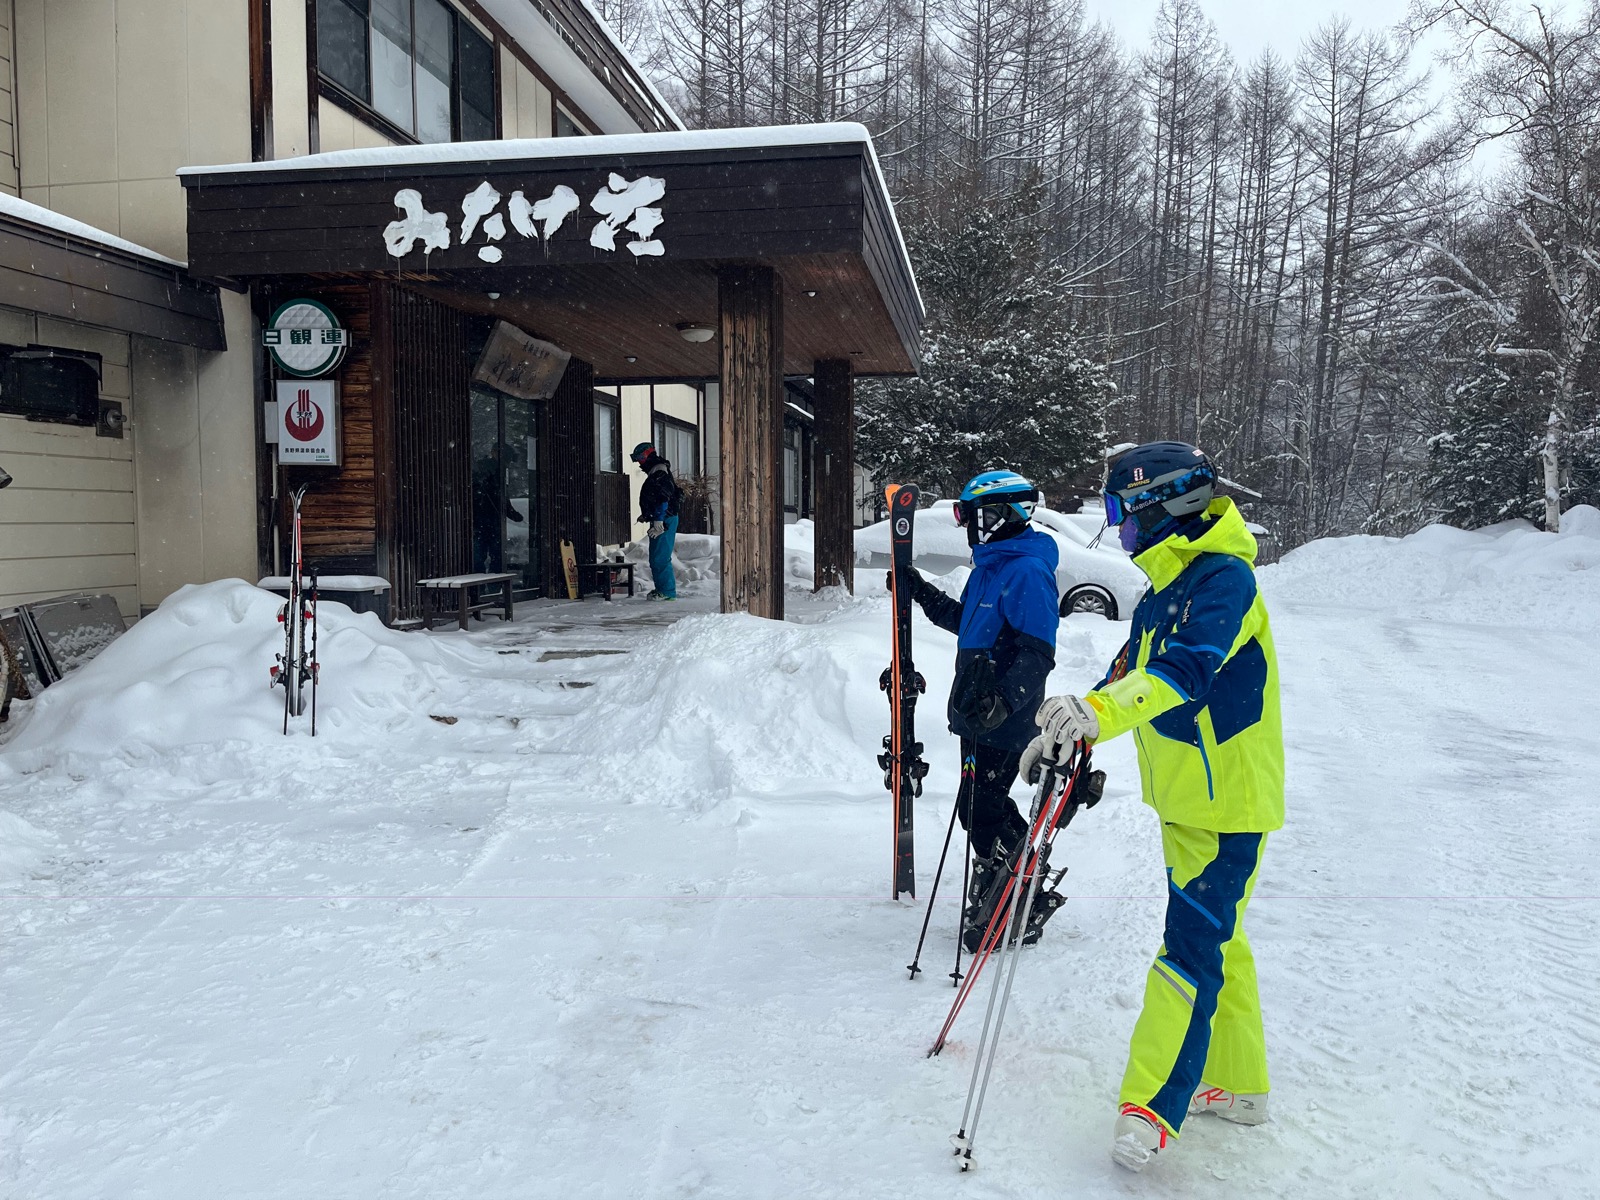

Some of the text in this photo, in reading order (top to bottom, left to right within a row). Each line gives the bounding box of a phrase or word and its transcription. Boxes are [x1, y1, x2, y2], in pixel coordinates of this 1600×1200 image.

[263, 328, 342, 345] 日観連
[1127, 478, 1151, 489] SWANS
[1011, 930, 1036, 943] HAD
